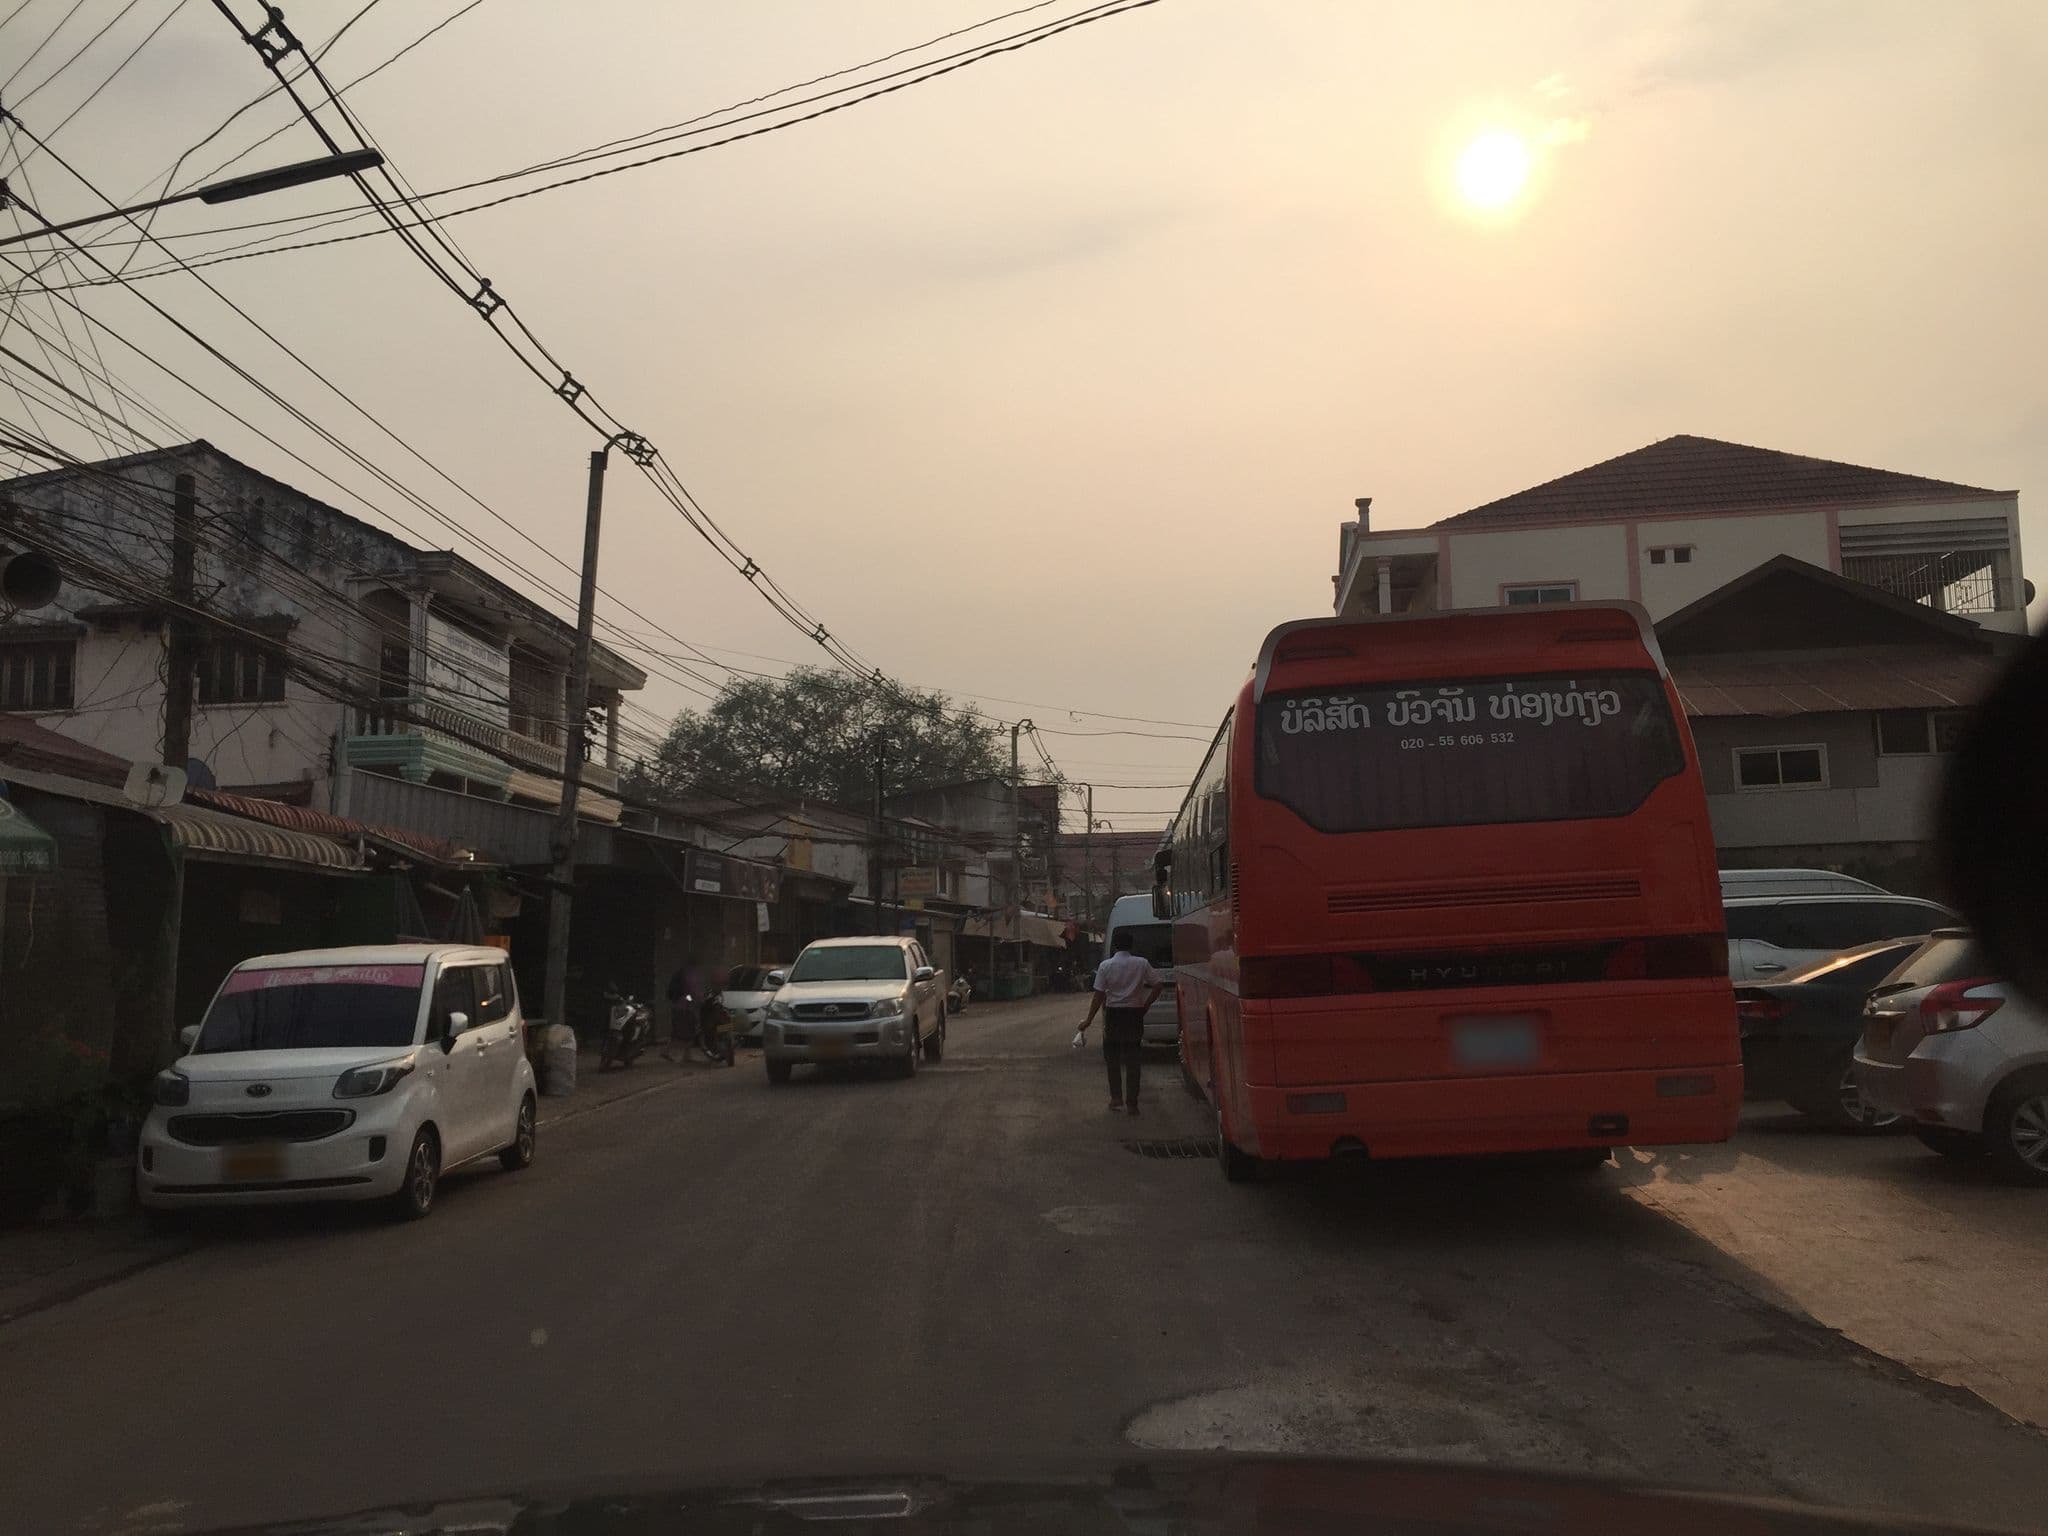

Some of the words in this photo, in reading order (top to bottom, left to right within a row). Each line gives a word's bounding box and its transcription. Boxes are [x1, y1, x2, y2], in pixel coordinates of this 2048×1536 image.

[1401, 737, 1425, 750] 020
[1438, 735, 1455, 746] 55
[1460, 734, 1484, 746] 606
[1490, 732, 1515, 744] 532
